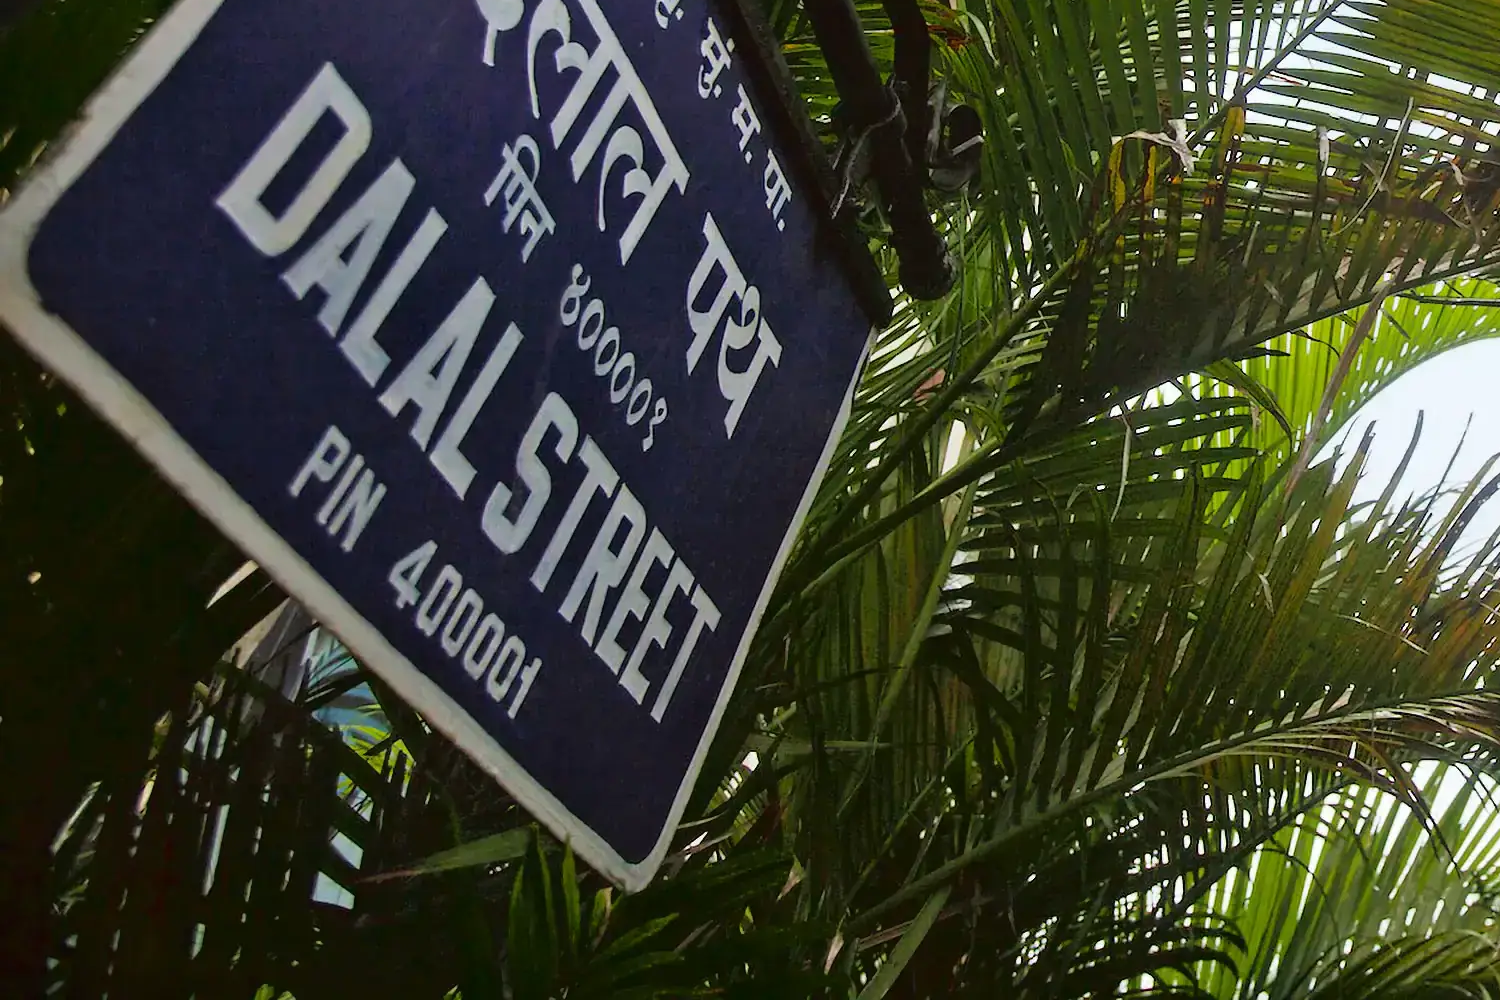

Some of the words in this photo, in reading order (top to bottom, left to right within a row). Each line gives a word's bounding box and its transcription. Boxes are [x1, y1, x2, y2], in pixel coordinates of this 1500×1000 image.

[216, 61, 523, 500] DALAL
[481, 391, 722, 723] STREET
[483, 136, 557, 264] पिन
[559, 263, 669, 453] ४००००१
[686, 211, 783, 439] पथ
[289, 426, 387, 553] PIN
[388, 539, 543, 720] 400001
